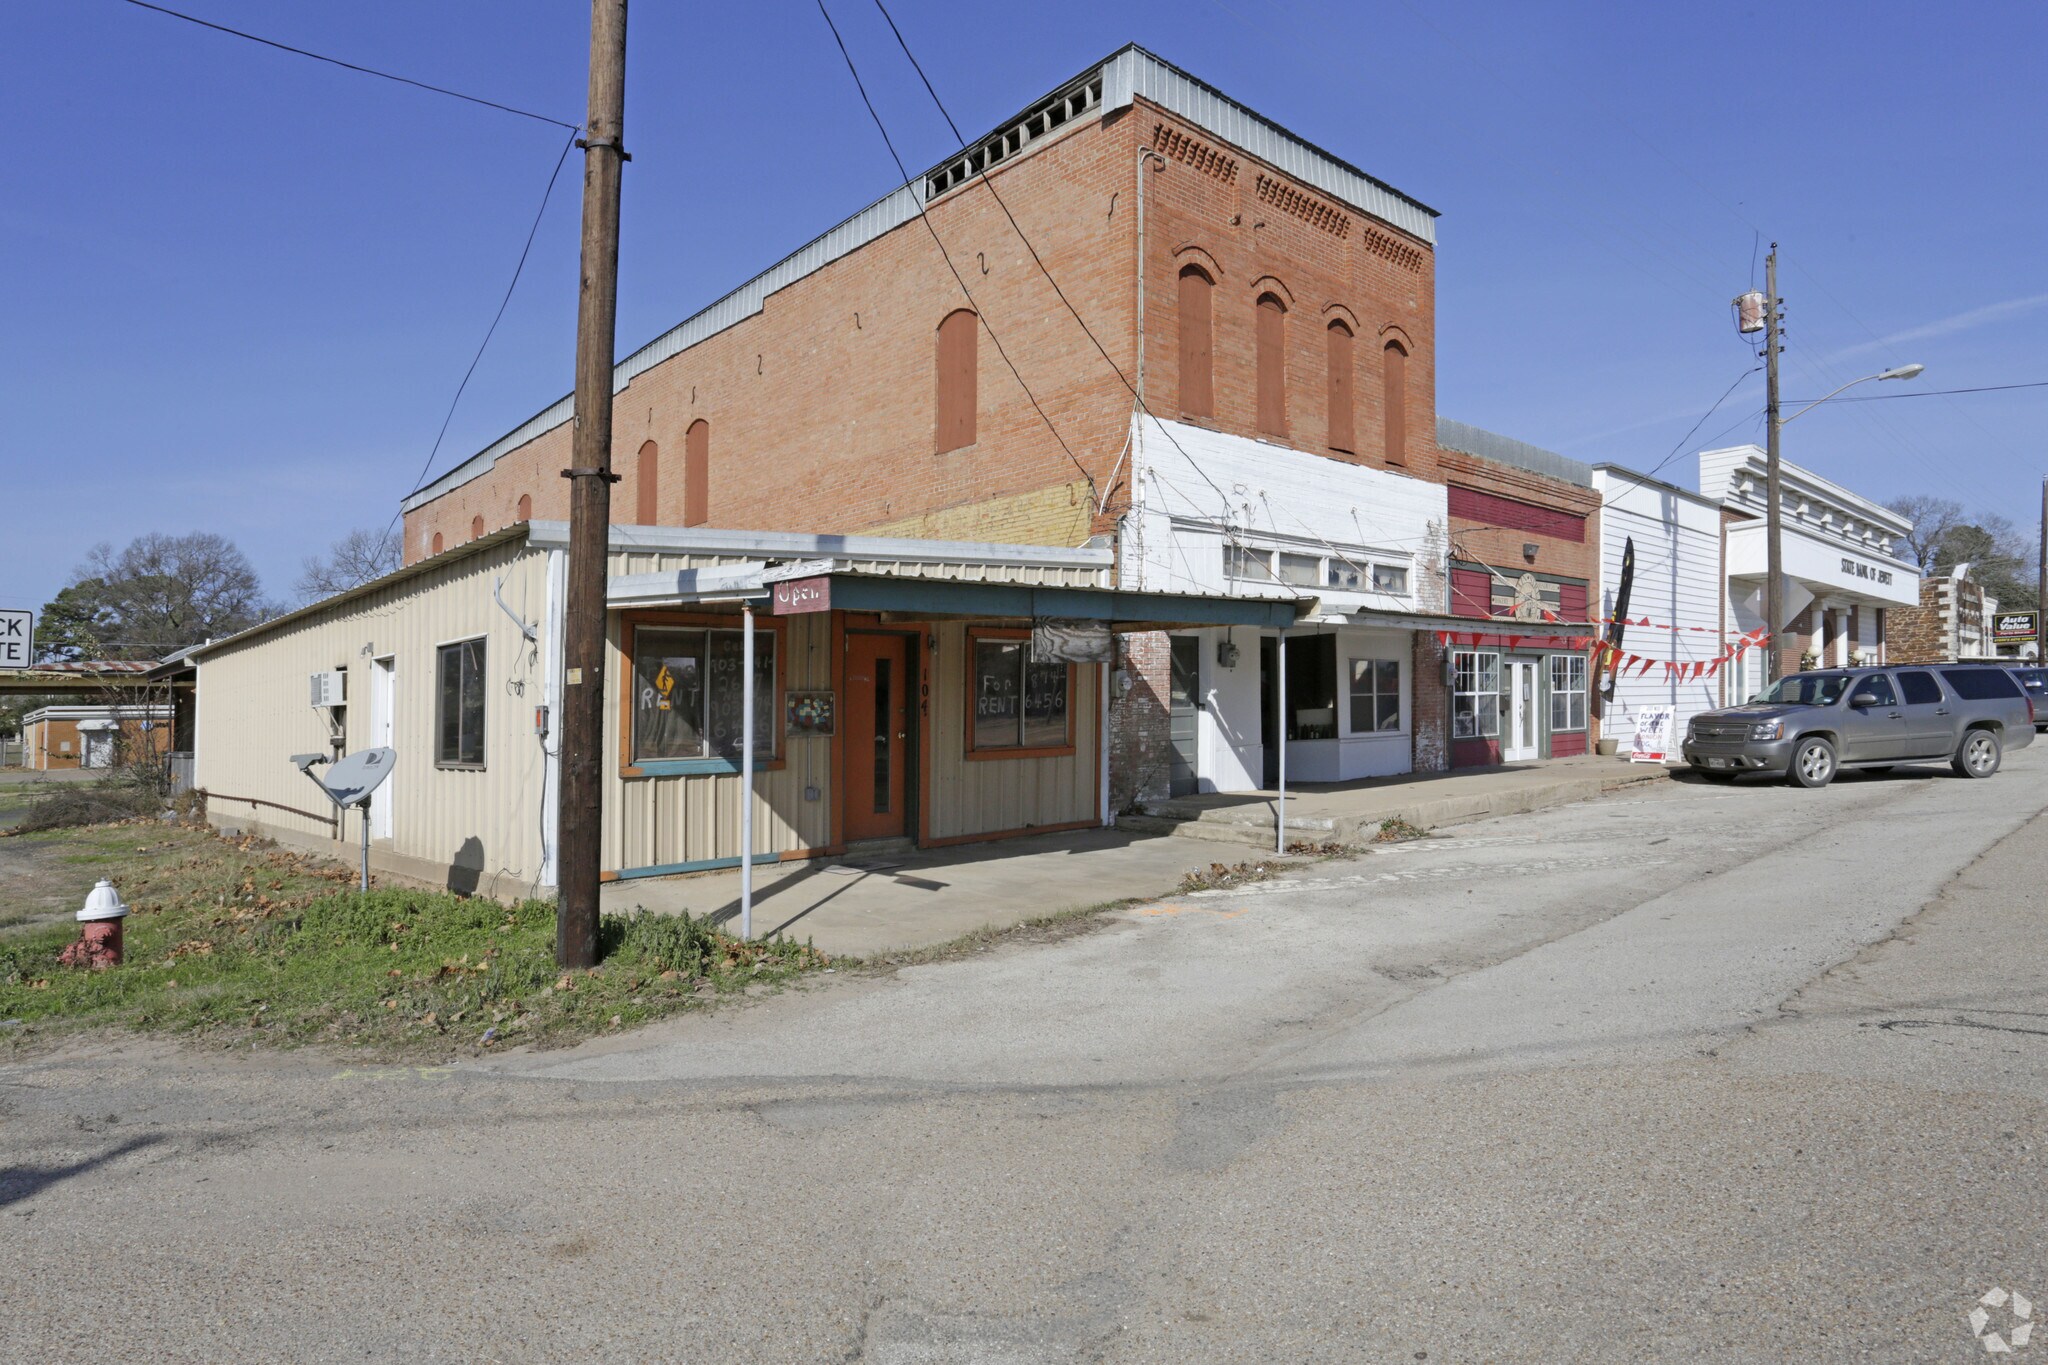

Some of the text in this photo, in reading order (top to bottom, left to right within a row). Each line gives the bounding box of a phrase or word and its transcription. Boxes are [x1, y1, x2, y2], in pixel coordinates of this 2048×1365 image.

[1841, 558, 1855, 575] STATE
[1856, 562, 1868, 579] BANK
[1870, 567, 1876, 581] OF
[2001, 616, 2030, 624] Auto
[978, 695, 1018, 715] RENT
[1025, 690, 1063, 710] 6456
[1640, 712, 1671, 720] FLAVOR
